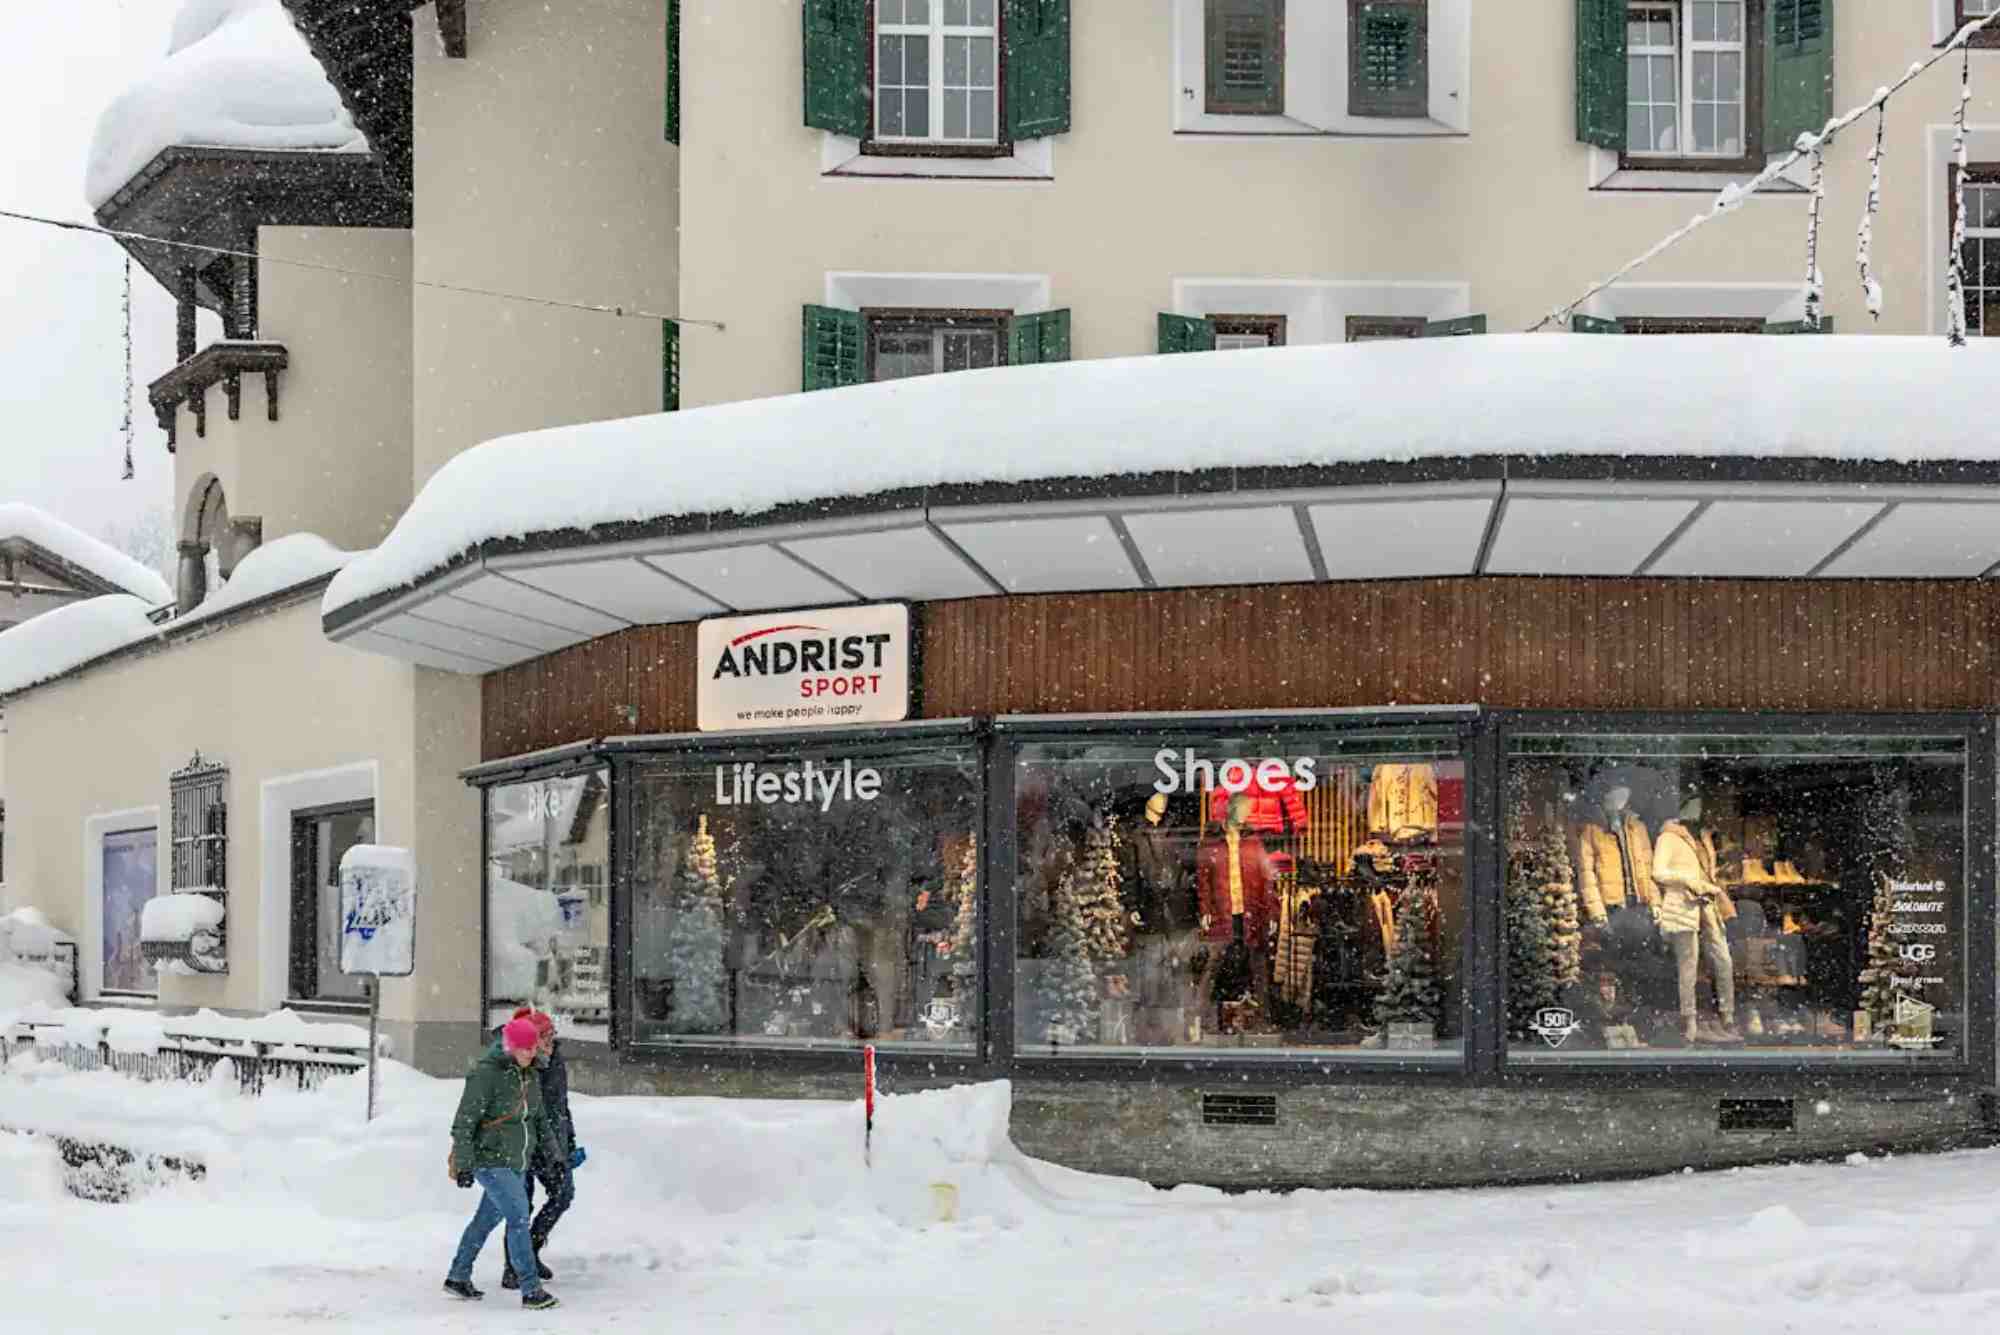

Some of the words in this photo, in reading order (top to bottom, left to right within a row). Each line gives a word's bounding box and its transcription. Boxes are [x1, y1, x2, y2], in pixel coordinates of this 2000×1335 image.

[713, 633, 891, 680] ANDRIST
[800, 675, 882, 698] SPORT
[736, 711, 752, 720] we
[753, 706, 784, 719] make
[786, 704, 824, 718] people
[826, 703, 863, 717] happy
[715, 759, 882, 812] Lifestyle
[1153, 747, 1317, 793] Shoes
[1899, 943, 1936, 961] UGG
